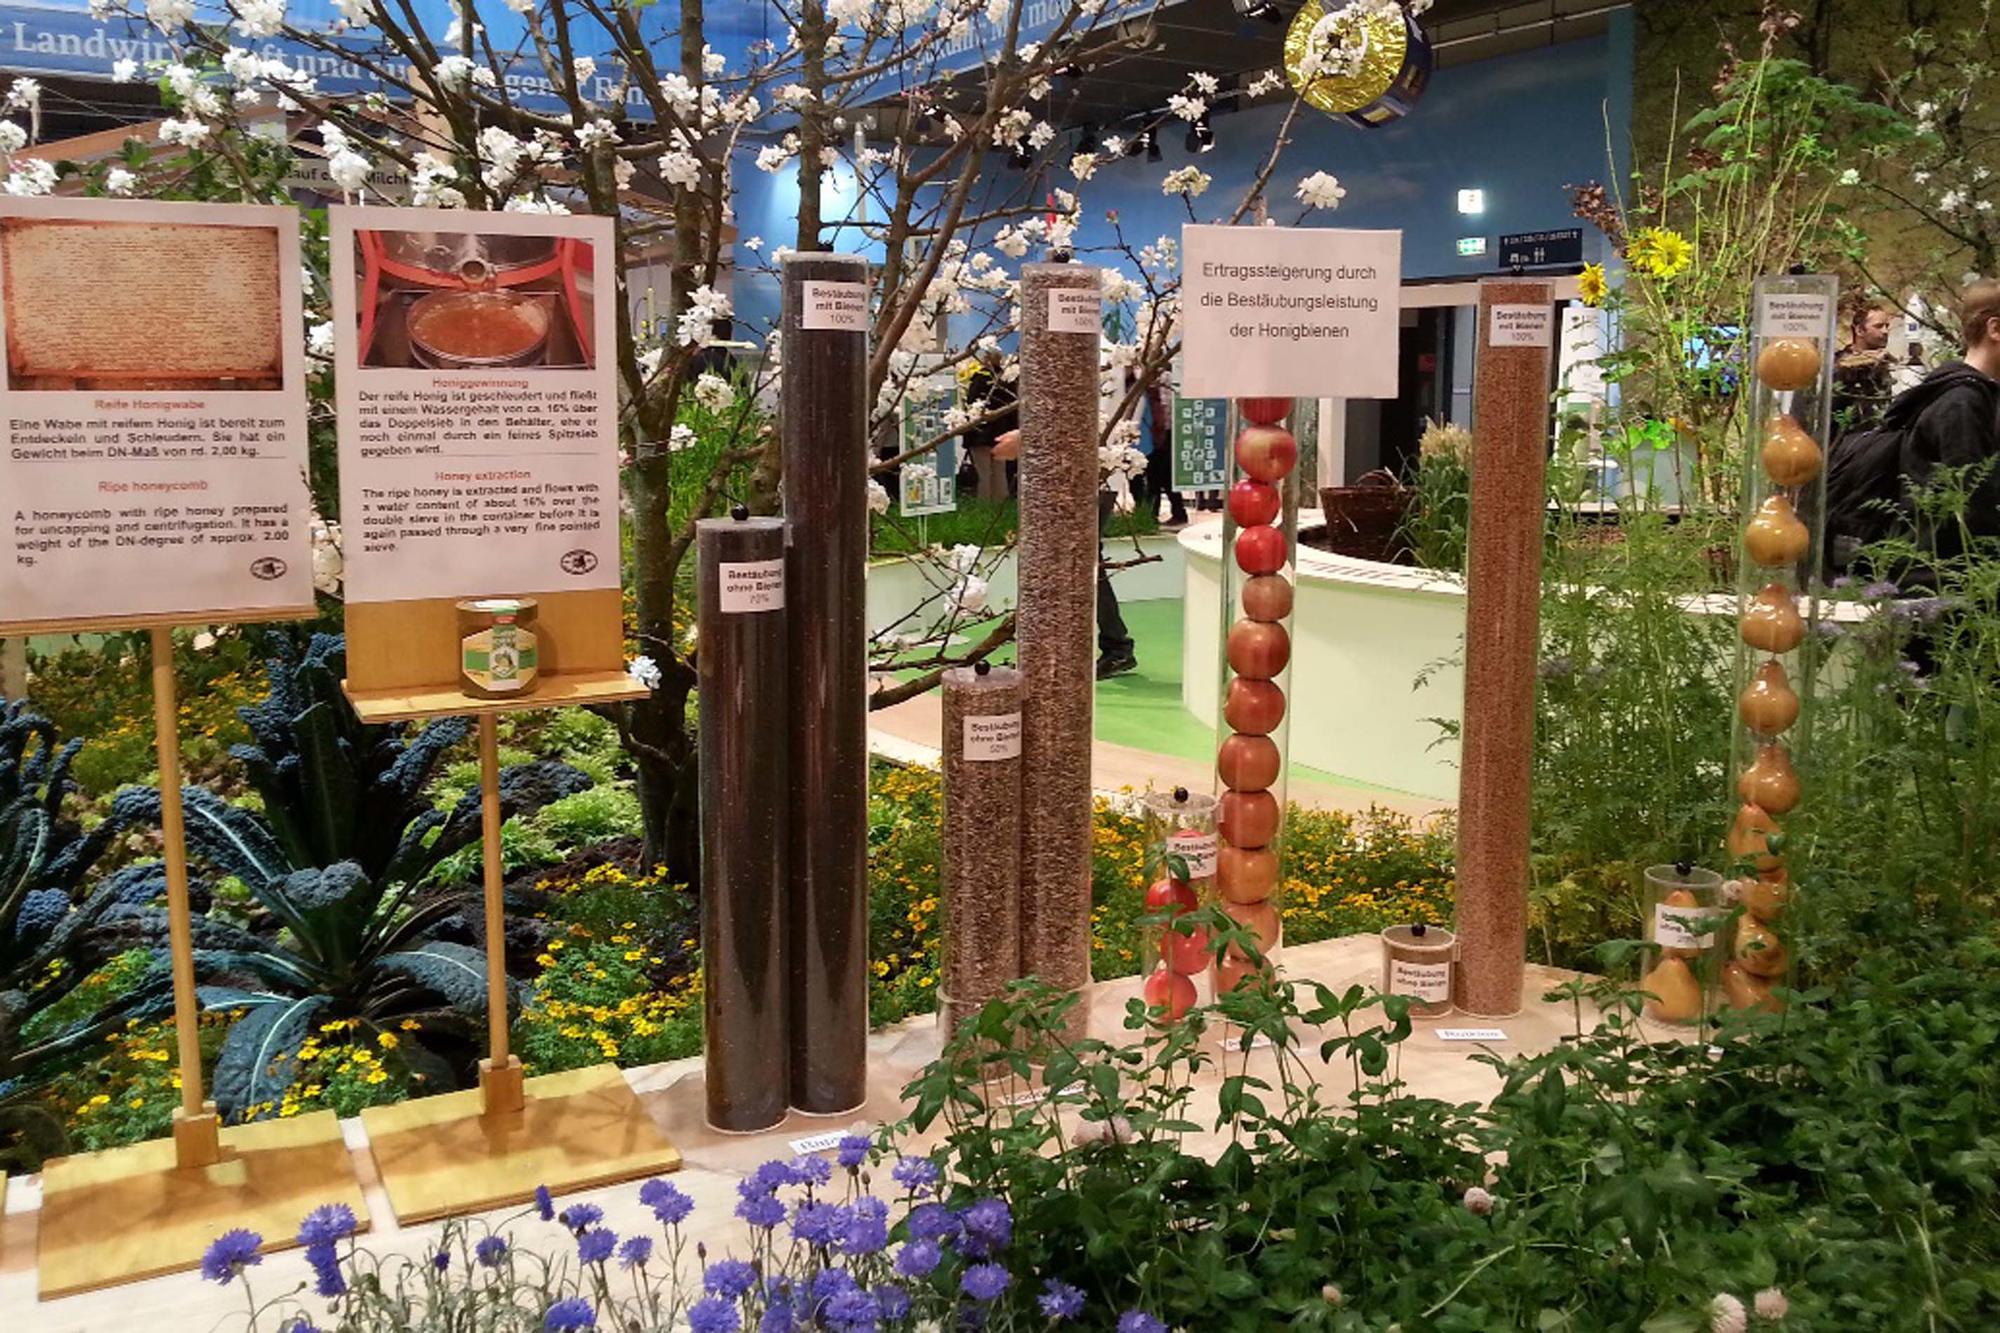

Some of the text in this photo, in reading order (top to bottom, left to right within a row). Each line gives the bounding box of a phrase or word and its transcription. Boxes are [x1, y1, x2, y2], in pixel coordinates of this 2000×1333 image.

[295, 51, 362, 81] und
[1202, 263, 1377, 283] Ertragssteigerung durch
[1200, 292, 1378, 312] die Bestäubungsleistung
[1230, 323, 1350, 341] der Honigbienen
[432, 378, 529, 391] Honiggewinnung
[359, 392, 379, 401] Der
[383, 391, 409, 401] reife
[414, 391, 448, 403] Honig
[452, 391, 466, 401] ist
[470, 391, 542, 403] geschleudert
[545, 391, 567, 401] und
[95, 400, 205, 411] Reife Honigwabe
[359, 405, 378, 415] mit
[382, 406, 418, 415] einem
[421, 405, 500, 416] Wassergehalt
[503, 406, 523, 414] von
[573, 404, 598, 413] über
[10, 418, 285, 430] Eine Wabe mit reifem Honig ist bereit zum
[359, 419, 381, 429] das
[388, 418, 454, 430] Doppelsieb
[460, 418, 471, 427] in
[477, 418, 499, 428] den
[561, 418, 581, 427] ehe
[587, 419, 598, 427] er
[11, 433, 87, 445] Entdeckeln
[94, 433, 119, 444] und
[212, 432, 233, 442] Sie
[239, 431, 259, 442] hat
[266, 431, 286, 442] ein
[360, 432, 390, 442] noch
[397, 431, 437, 442] einmal
[443, 430, 476, 440] durch
[483, 431, 501, 440] ein
[508, 430, 541, 440] feines
[11, 448, 67, 460] Gewicht
[71, 447, 103, 458] beim
[163, 448, 187, 457] von
[361, 445, 412, 457] gegeben
[435, 469, 531, 482] Honey extraction
[98, 480, 208, 493] Ripe honeycomb
[362, 483, 599, 500] The ripe honey is extracted and flows with
[377, 502, 409, 511] water
[416, 500, 460, 510] content
[466, 499, 477, 509] of
[484, 498, 516, 508] about
[552, 498, 576, 506] over
[581, 496, 600, 505] the
[15, 504, 288, 522] A honeycomb with ripe honey prepared
[363, 508, 599, 526] double sieve in the container before it is
[15, 525, 34, 535] for
[40, 523, 110, 537] uncapping
[115, 522, 139, 532] and
[254, 518, 277, 528] has
[363, 528, 397, 540] again
[400, 527, 442, 539] passed
[445, 525, 490, 537] through
[503, 525, 529, 536] very
[535, 522, 555, 532] fine
[559, 521, 600, 533] pointed
[16, 538, 61, 552] weight
[68, 538, 82, 548] of
[88, 537, 109, 548] the
[115, 535, 184, 548] DN-degree
[191, 533, 204, 543] of
